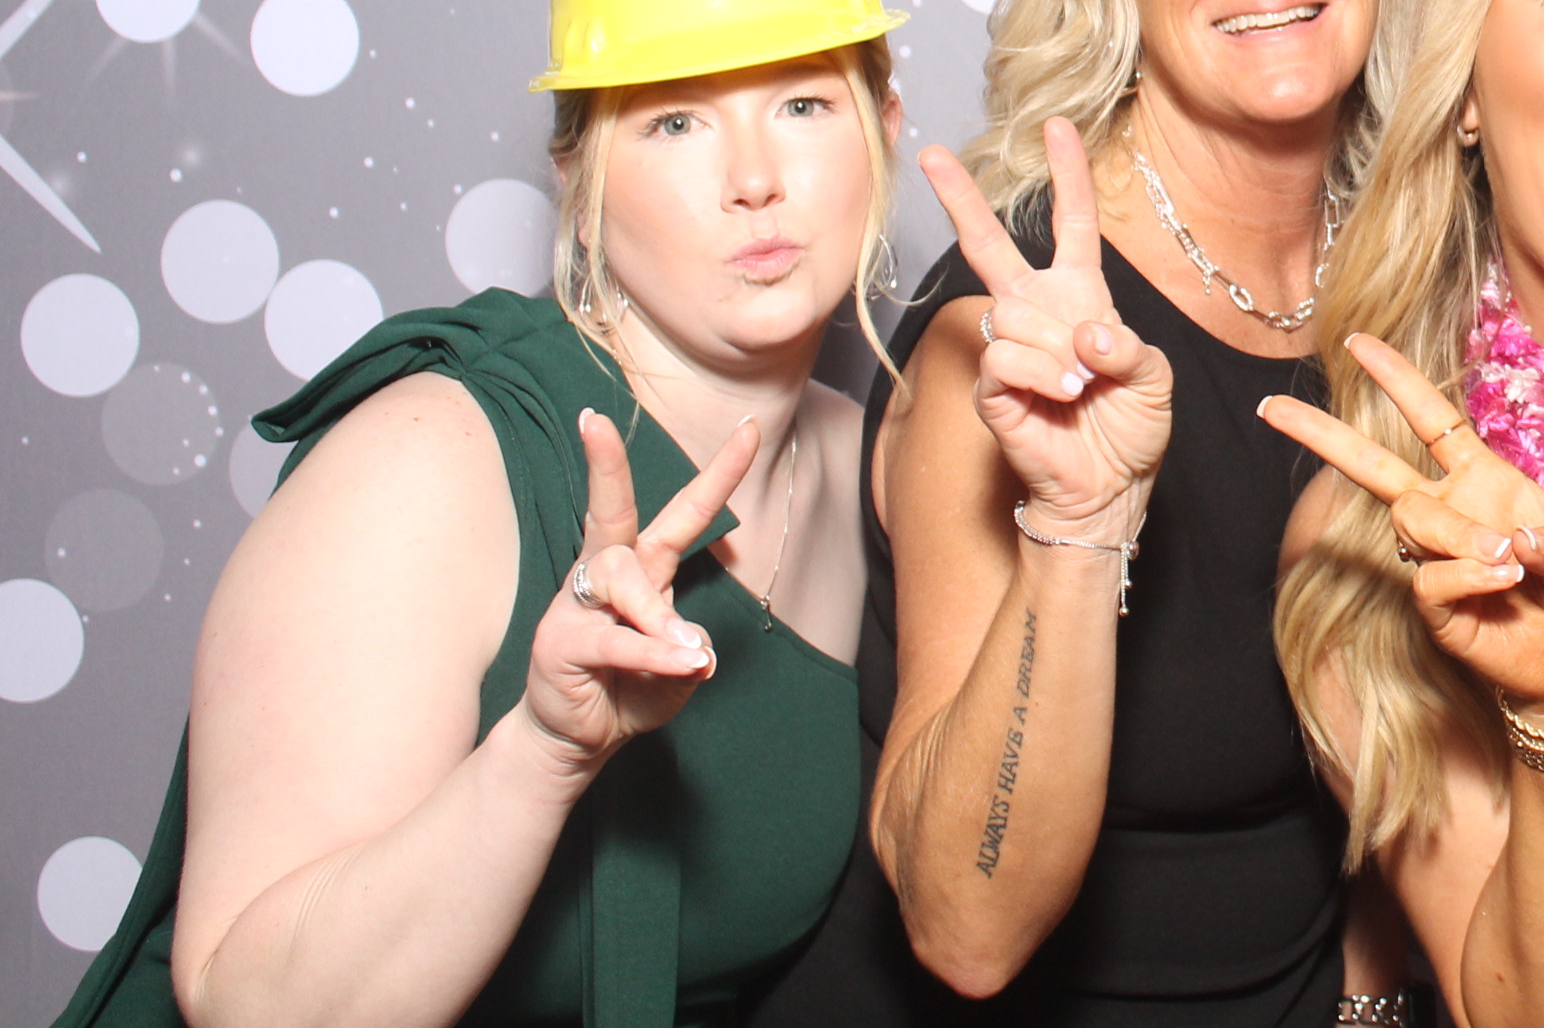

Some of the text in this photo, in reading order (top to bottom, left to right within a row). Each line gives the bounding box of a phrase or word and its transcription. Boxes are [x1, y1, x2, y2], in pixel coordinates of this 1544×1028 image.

[975, 606, 1038, 879] ALWAYS HAVE A DREAM
